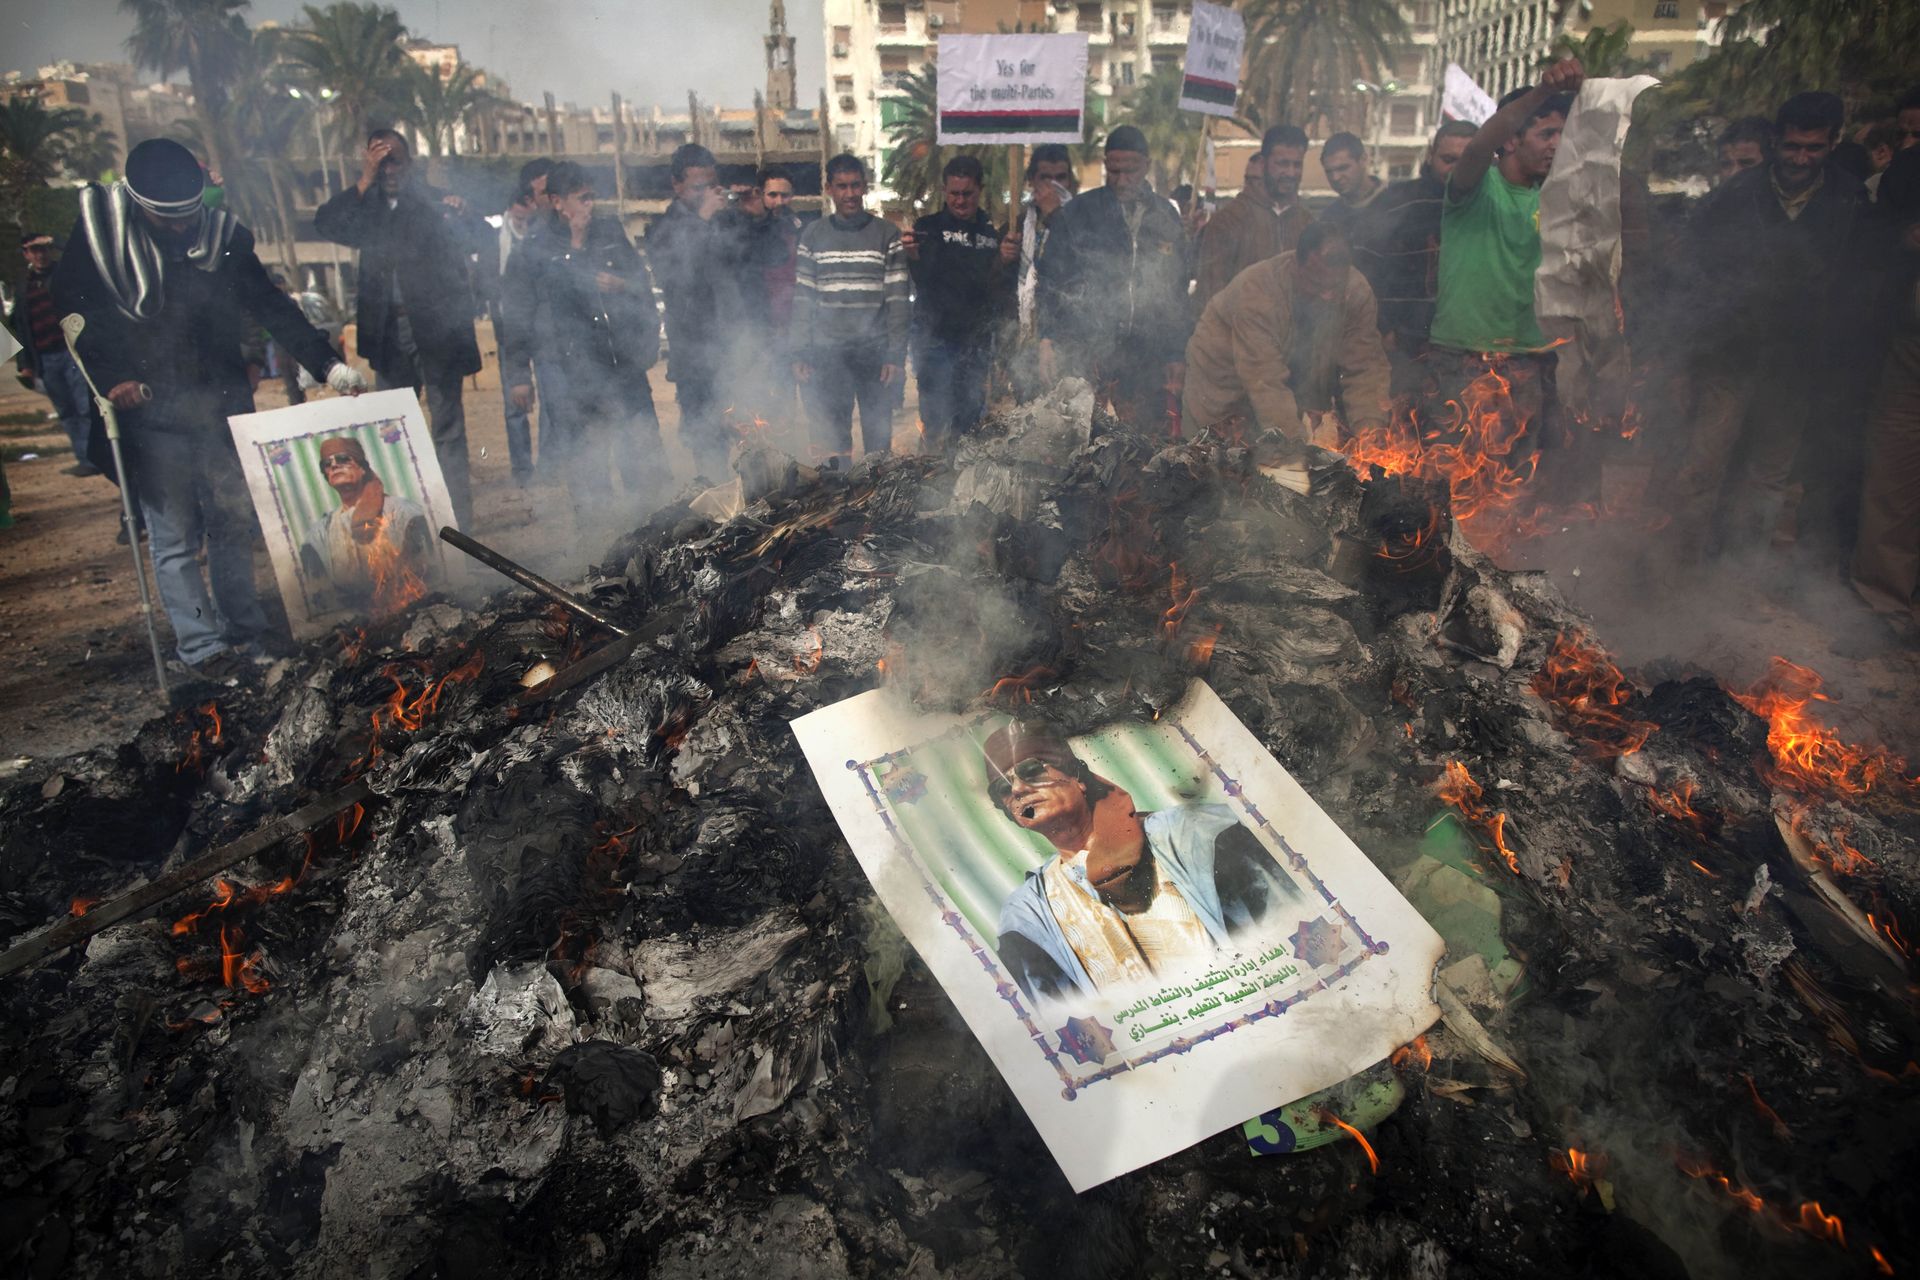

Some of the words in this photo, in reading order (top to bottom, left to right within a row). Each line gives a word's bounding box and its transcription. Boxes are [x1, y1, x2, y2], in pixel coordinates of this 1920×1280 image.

[996, 59, 1014, 77] Yes
[1019, 59, 1036, 76] for
[970, 84, 987, 102] the
[991, 83, 1056, 101] multi-Parties
[1230, 958, 1261, 977] إدارة
[1257, 964, 1301, 989] باللجنة
[1191, 968, 1234, 992] التثقيف
[1148, 985, 1193, 1007] والنشاط
[1219, 981, 1262, 1003] الشعبية
[1113, 999, 1150, 1025] المدرسي
